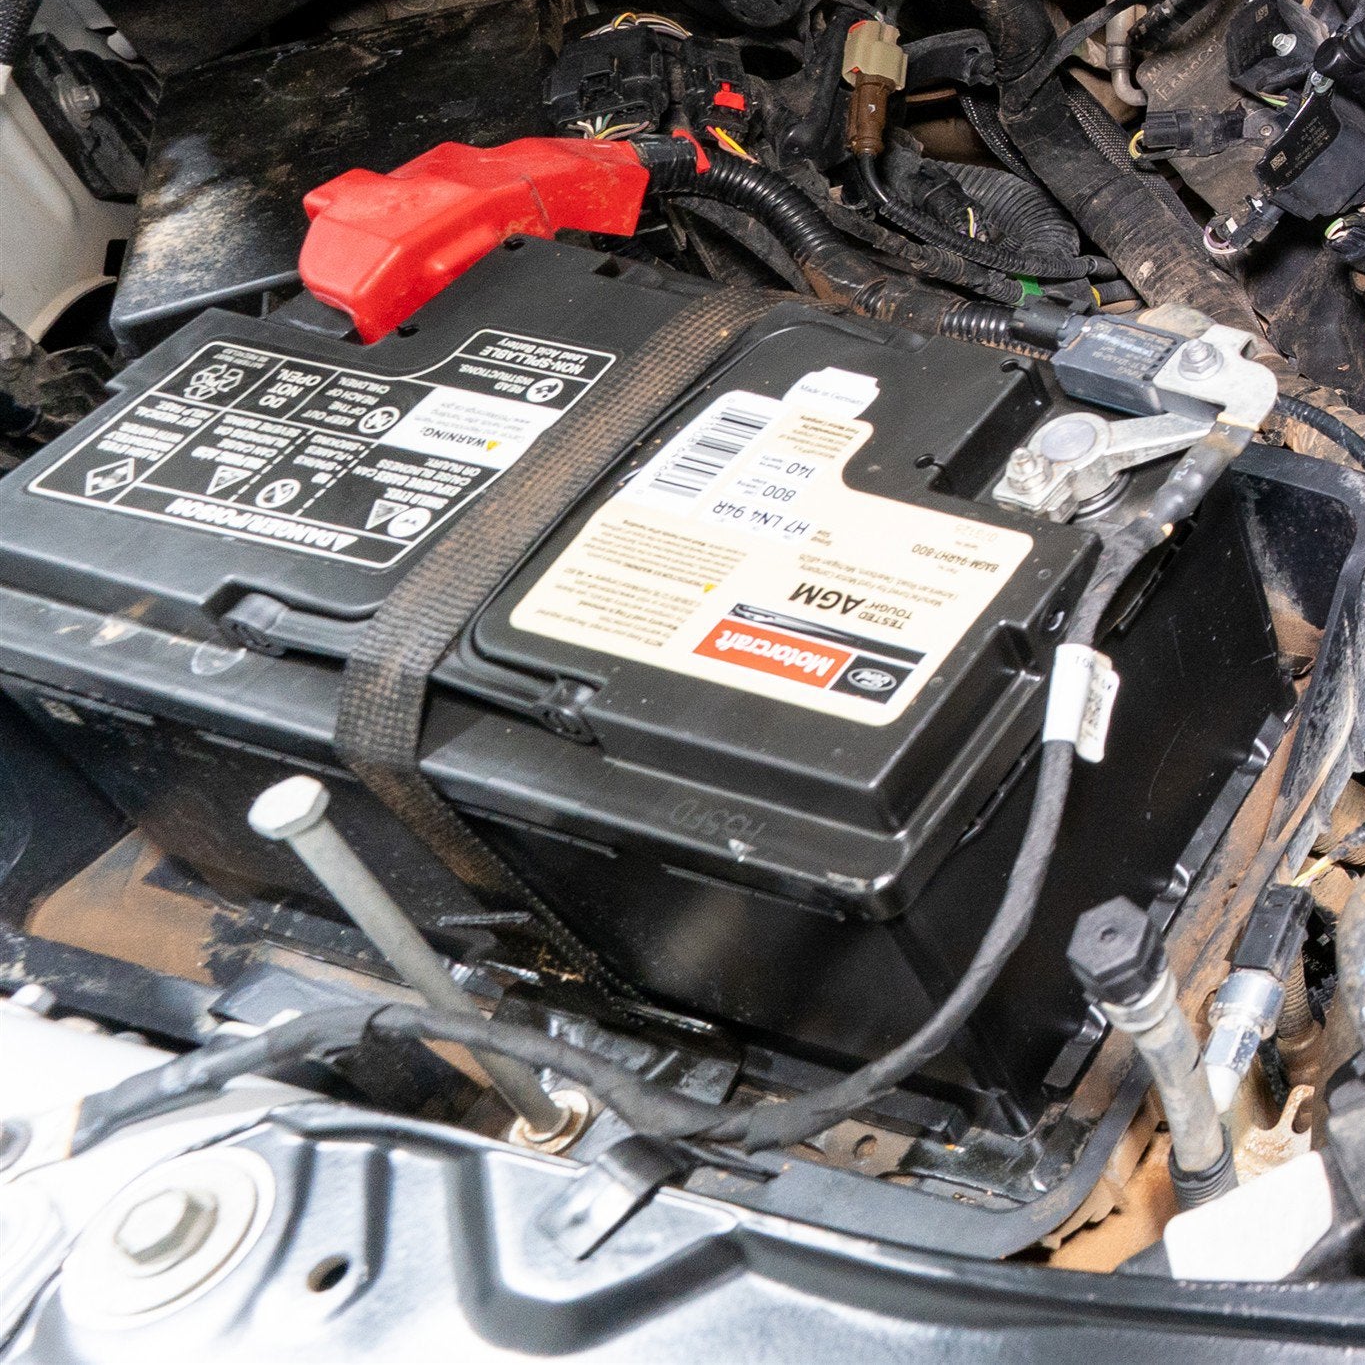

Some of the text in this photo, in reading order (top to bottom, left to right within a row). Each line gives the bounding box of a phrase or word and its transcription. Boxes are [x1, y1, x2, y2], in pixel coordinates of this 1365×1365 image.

[494, 336, 589, 363] Lead Acid Battery
[477, 344, 586, 375] NON-SPILLABLE
[270, 367, 325, 387] OPEN.
[454, 362, 536, 386] INSTRUCTIONS.
[265, 381, 304, 397] NOT
[333, 375, 393, 395] CHILDREN.
[491, 380, 527, 394] READ
[256, 393, 288, 408] DO
[338, 389, 381, 405] REACH
[130, 405, 182, 423] MEDICAL
[322, 412, 358, 426] KEEP
[307, 433, 362, 451] SMOKING
[416, 425, 489, 447] WARNING:
[301, 444, 351, 461] FLAMES
[290, 454, 339, 471] SPARKS
[372, 458, 474, 486] CAUSE BLINDNESS
[420, 457, 467, 473] INJURY.
[783, 461, 816, 479] 140
[760, 483, 797, 502] 800
[161, 496, 343, 547] DANGER/POISON
[710, 499, 810, 535] H7 LN4 94R
[787, 581, 866, 617] AGM
[857, 610, 906, 629] TESTED
[709, 628, 837, 677] Motorcraft
